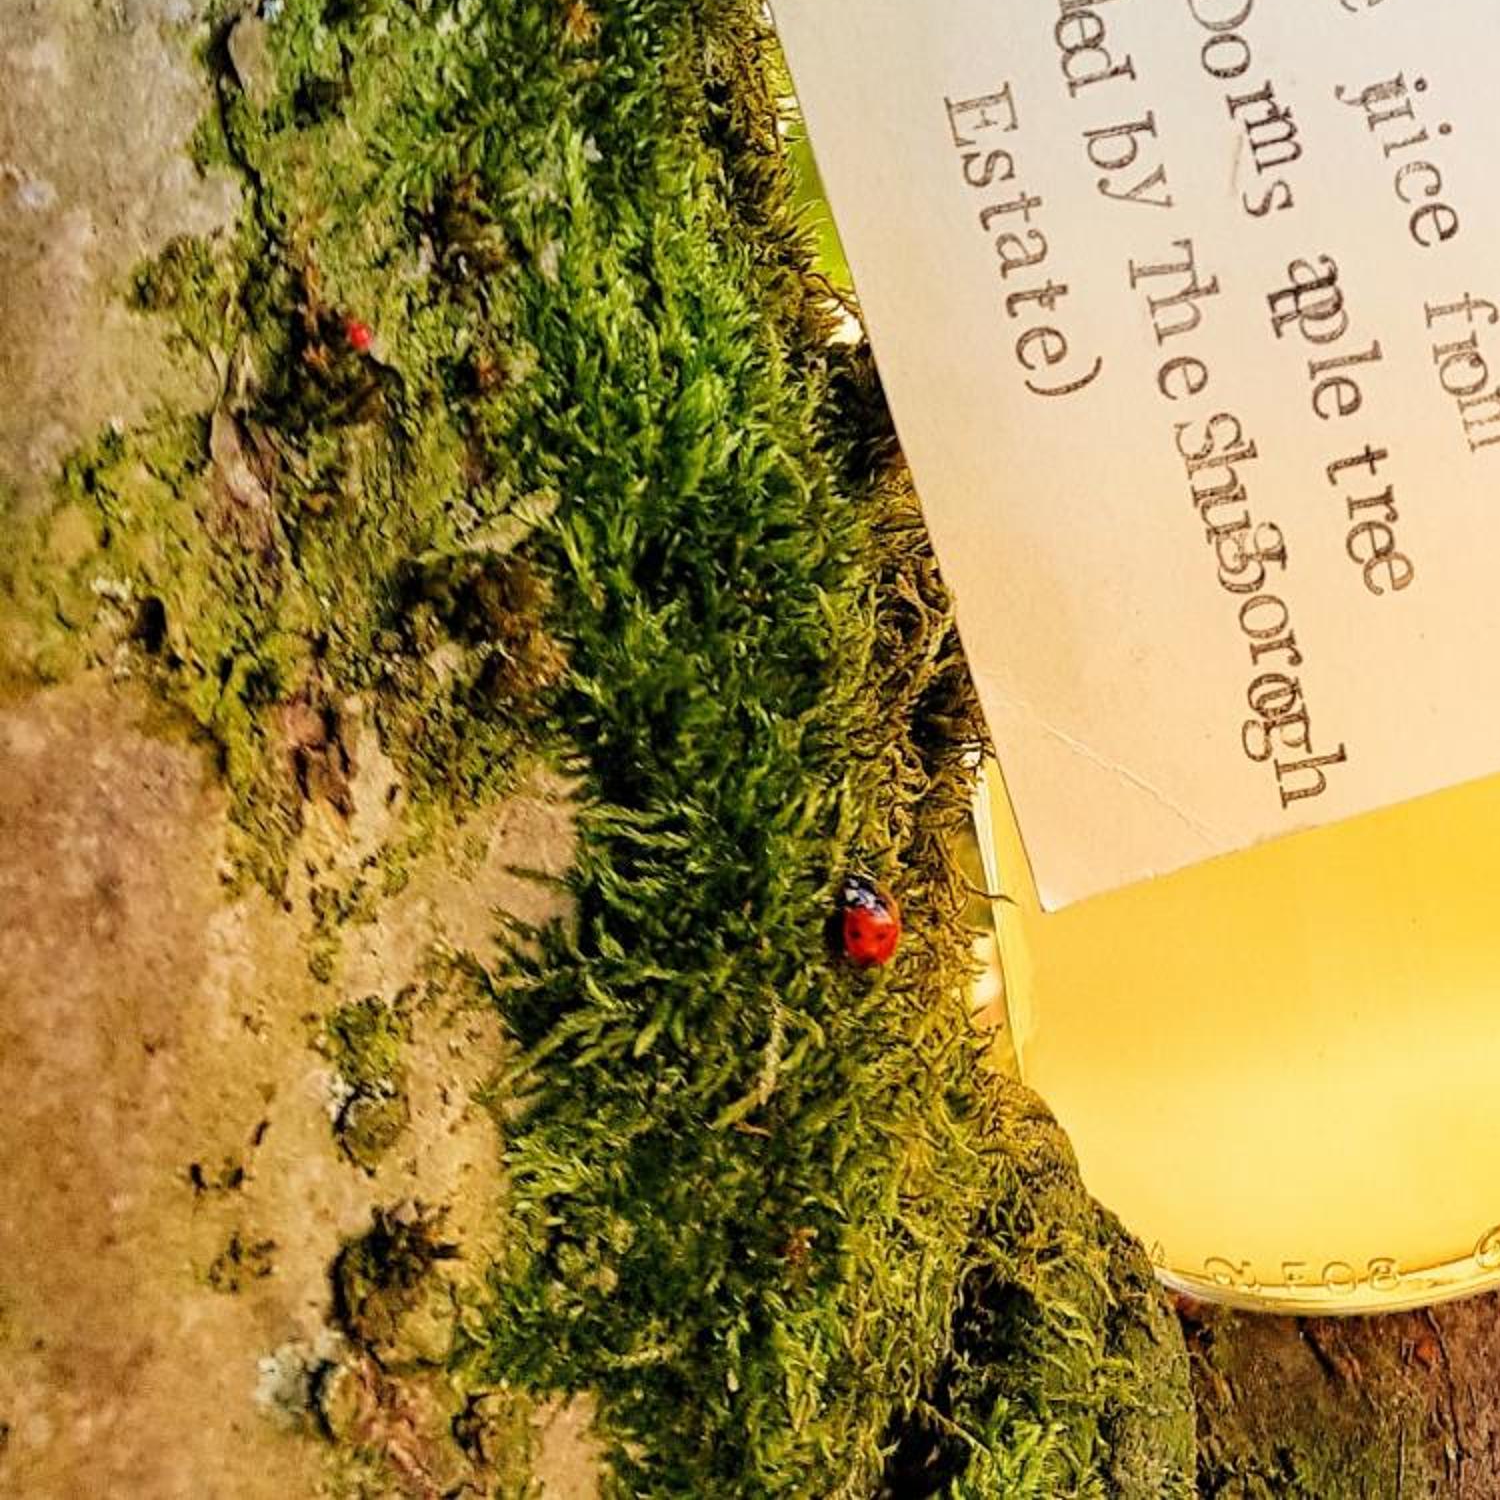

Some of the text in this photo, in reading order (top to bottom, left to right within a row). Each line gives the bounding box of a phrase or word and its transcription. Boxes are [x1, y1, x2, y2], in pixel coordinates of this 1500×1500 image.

[943, 81, 1103, 397] Estate)
[1081, 109, 1174, 209] by
[1334, 71, 1460, 248] juice
[1127, 238, 1221, 401] The
[1265, 253, 1383, 421] apple
[1325, 443, 1415, 597] tree
